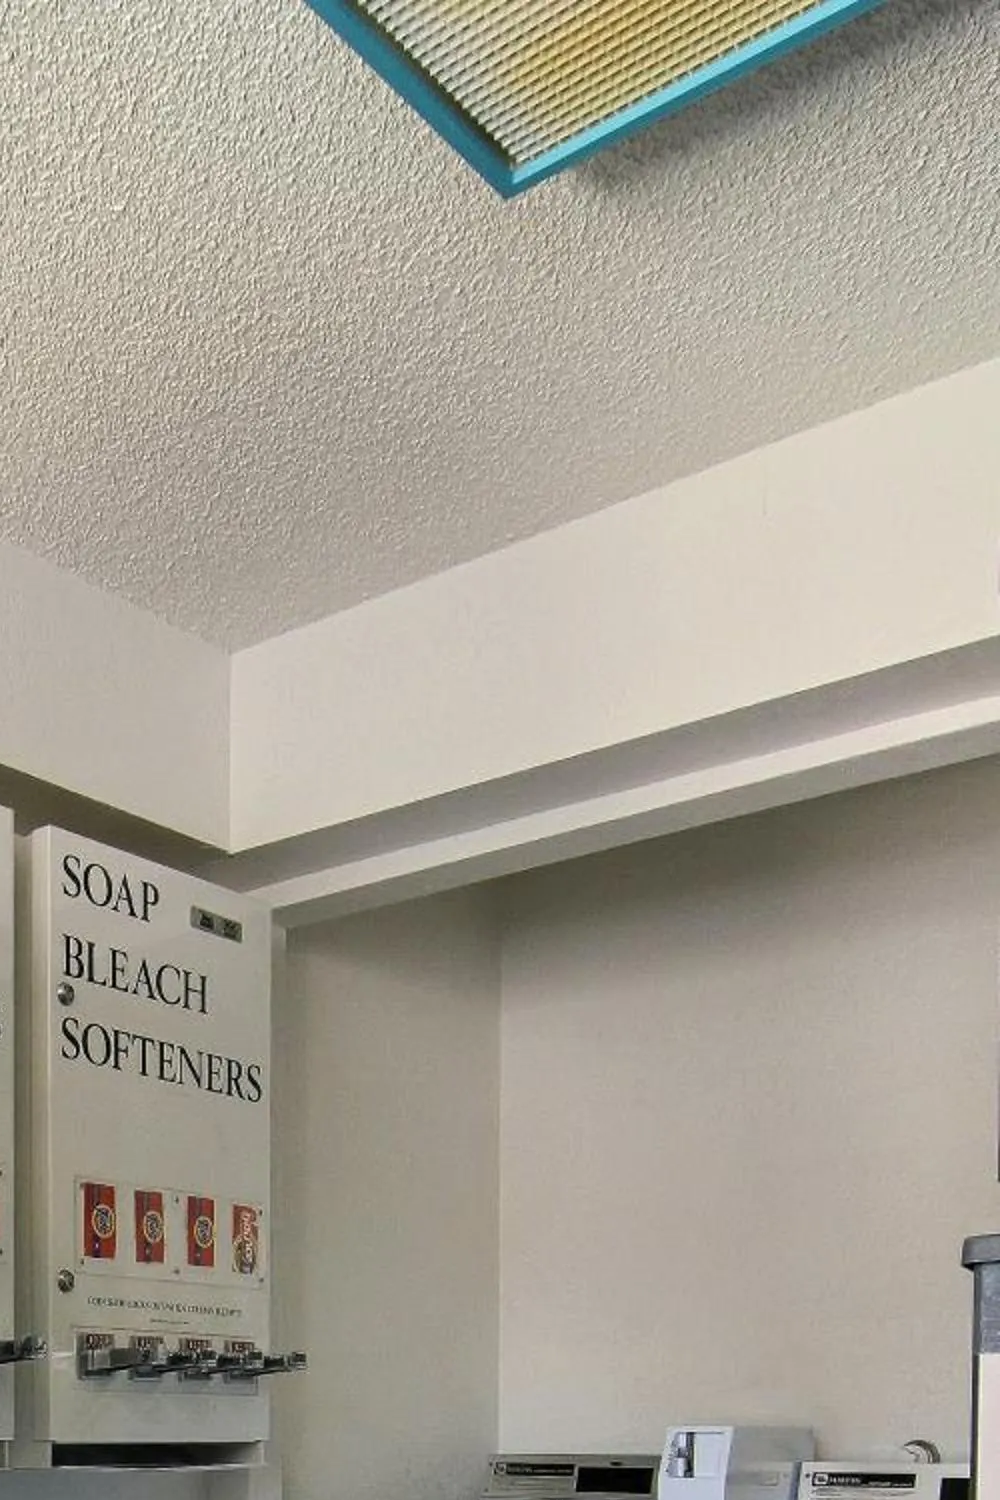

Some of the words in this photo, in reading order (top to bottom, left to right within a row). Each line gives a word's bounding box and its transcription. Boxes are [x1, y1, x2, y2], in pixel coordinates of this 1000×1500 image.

[62, 854, 160, 922] SOAP
[62, 933, 209, 1015] BLEACH
[61, 1017, 263, 1103] SOFTENERS
